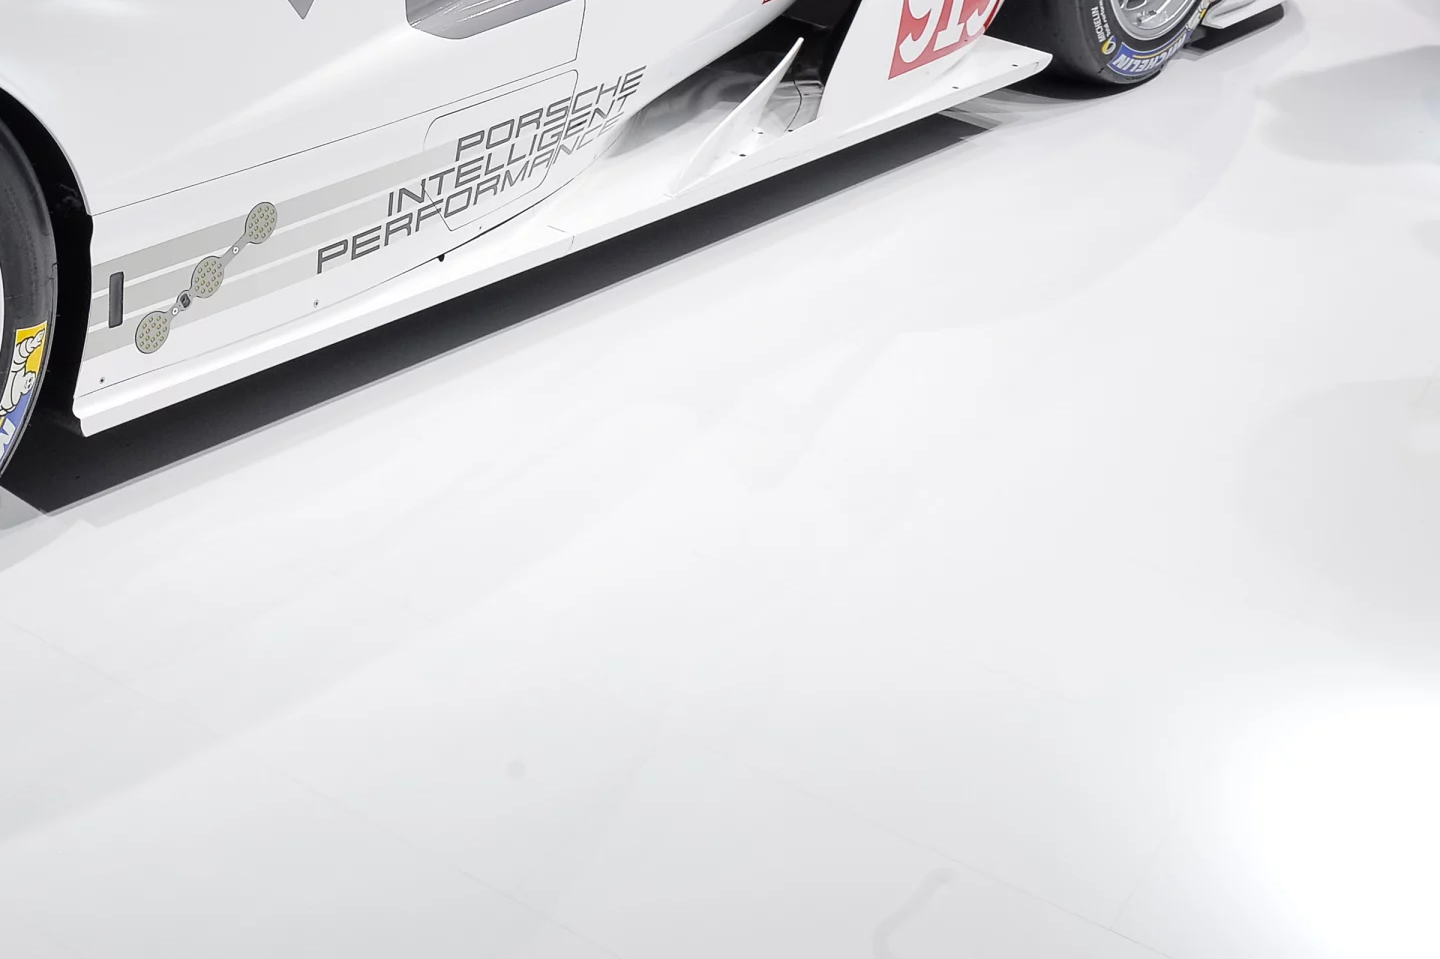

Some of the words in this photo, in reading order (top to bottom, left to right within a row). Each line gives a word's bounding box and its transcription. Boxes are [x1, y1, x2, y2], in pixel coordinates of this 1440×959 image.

[386, 90, 638, 218] INTELLIGENT
[454, 64, 647, 163] PORSCHE
[315, 111, 626, 276] PERFORMANCE
